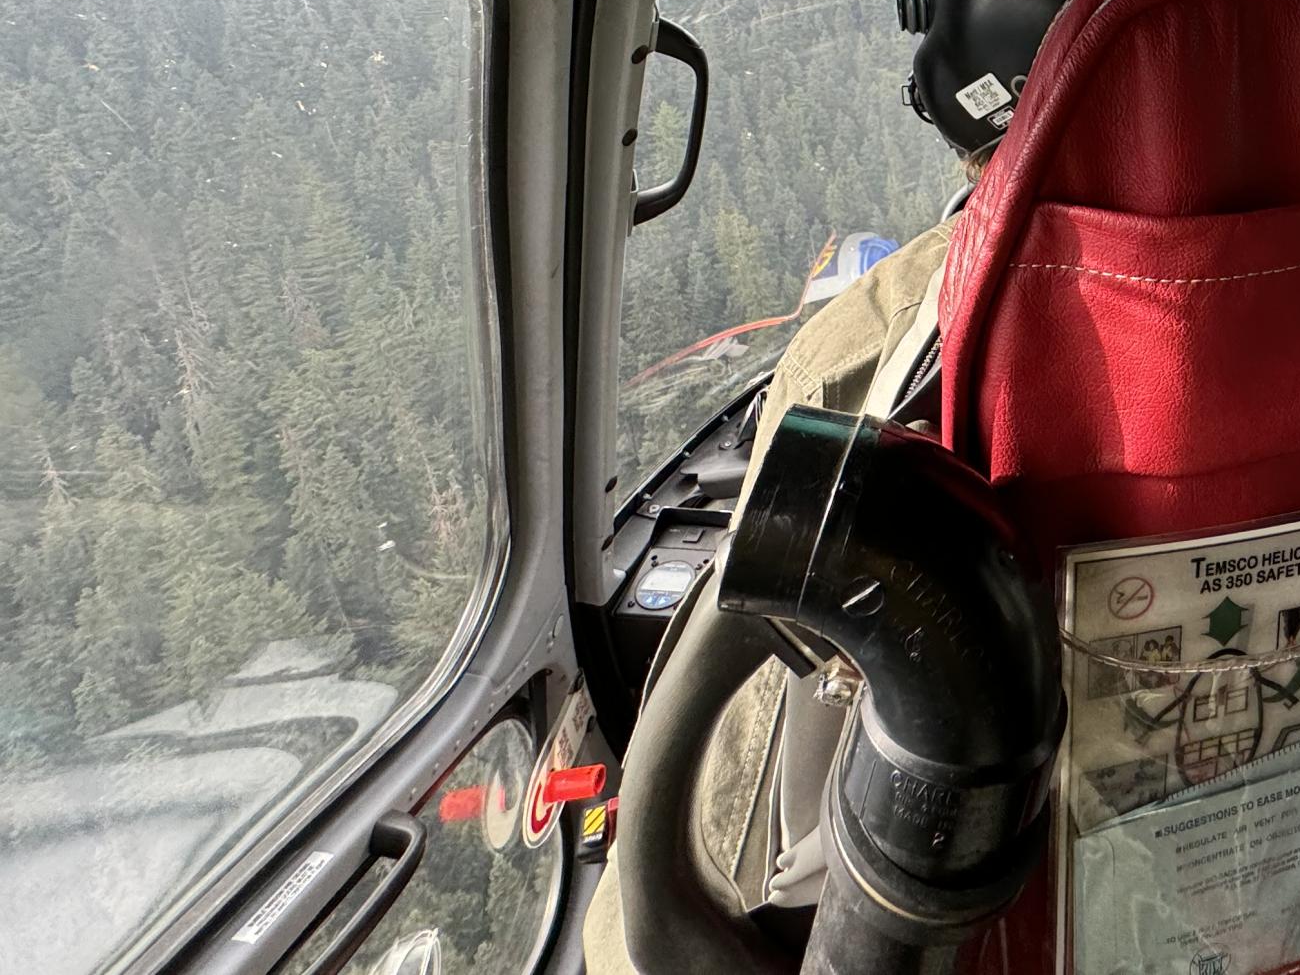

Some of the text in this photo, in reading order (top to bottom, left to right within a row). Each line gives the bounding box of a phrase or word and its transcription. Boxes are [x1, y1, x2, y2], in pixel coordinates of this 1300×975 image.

[1191, 555, 1258, 578] TEMSCO
[1200, 578, 1222, 594] AS
[1225, 574, 1253, 590] 350
[1164, 807, 1238, 836] SUGGESTIONS
[1240, 802, 1254, 813] TO
[1257, 792, 1283, 807] EASE
[1254, 815, 1275, 828] VENT
